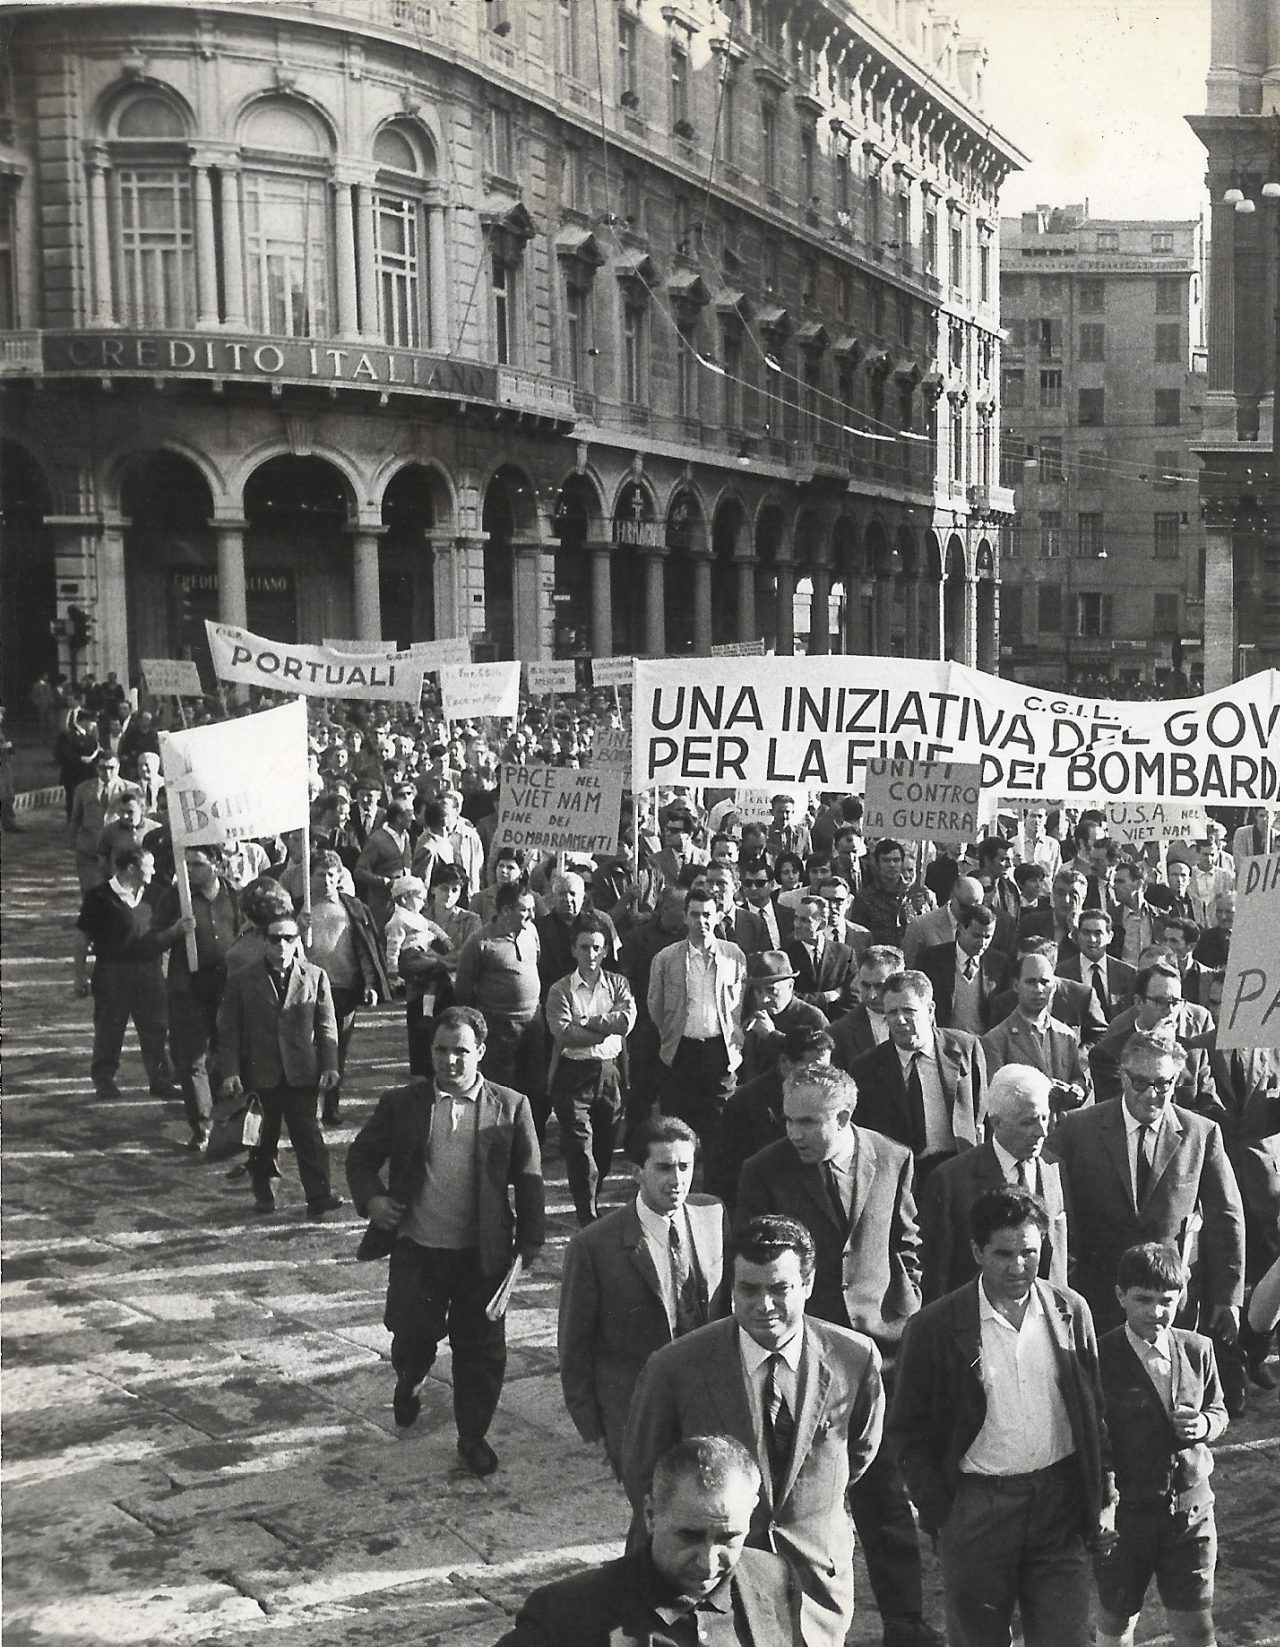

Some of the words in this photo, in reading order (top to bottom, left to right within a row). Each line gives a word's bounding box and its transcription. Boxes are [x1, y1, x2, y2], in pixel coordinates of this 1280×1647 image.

[68, 340, 284, 372] CREDITO
[310, 347, 485, 393] ITALIANO
[231, 645, 395, 687] PORTUALI
[1024, 696, 1119, 720] C.G.I.L.
[651, 686, 763, 730] UNA
[781, 686, 1036, 755] INIZIATIVA
[648, 735, 749, 780] PER
[766, 737, 828, 783] LA
[980, 753, 1046, 790] DEI
[871, 759, 952, 779] UNITI
[505, 766, 556, 788] PACE
[575, 776, 600, 788] NEL
[511, 788, 552, 808] VIET
[557, 791, 601, 813] NAM
[889, 782, 978, 804] CONTRO
[502, 811, 532, 823] FINE
[549, 815, 570, 827] DEI
[866, 811, 883, 827] LA
[893, 809, 973, 832] GUERRA
[1181, 810, 1199, 819] NEL
[1122, 826, 1155, 840] VIET
[1162, 825, 1191, 837] NAM
